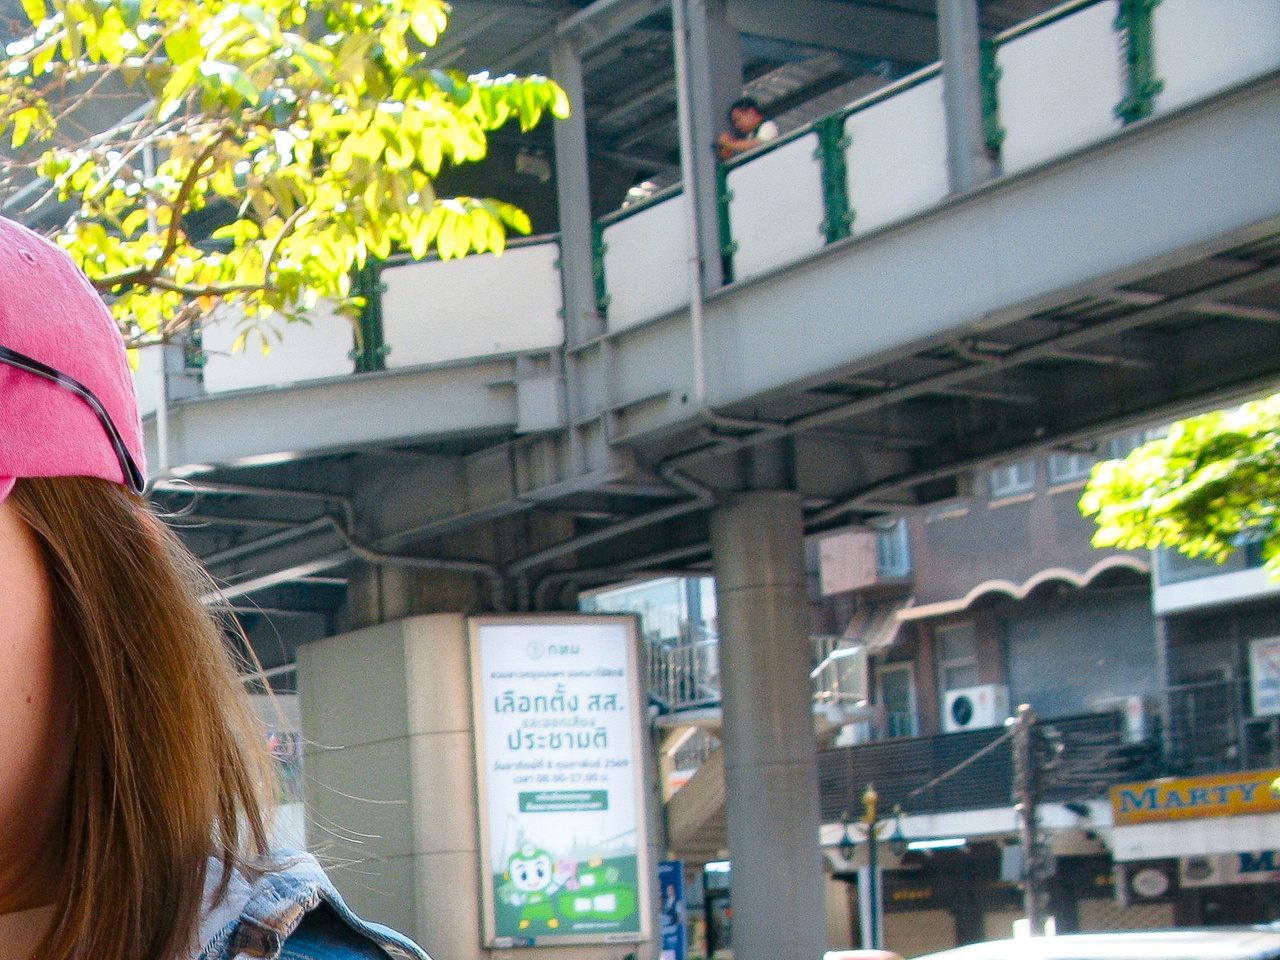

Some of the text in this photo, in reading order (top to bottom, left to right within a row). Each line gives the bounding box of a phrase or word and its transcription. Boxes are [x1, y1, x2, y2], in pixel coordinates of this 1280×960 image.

[495, 682, 625, 713] เลือกตั้ง สส.
[508, 727, 608, 750] ประชามติ
